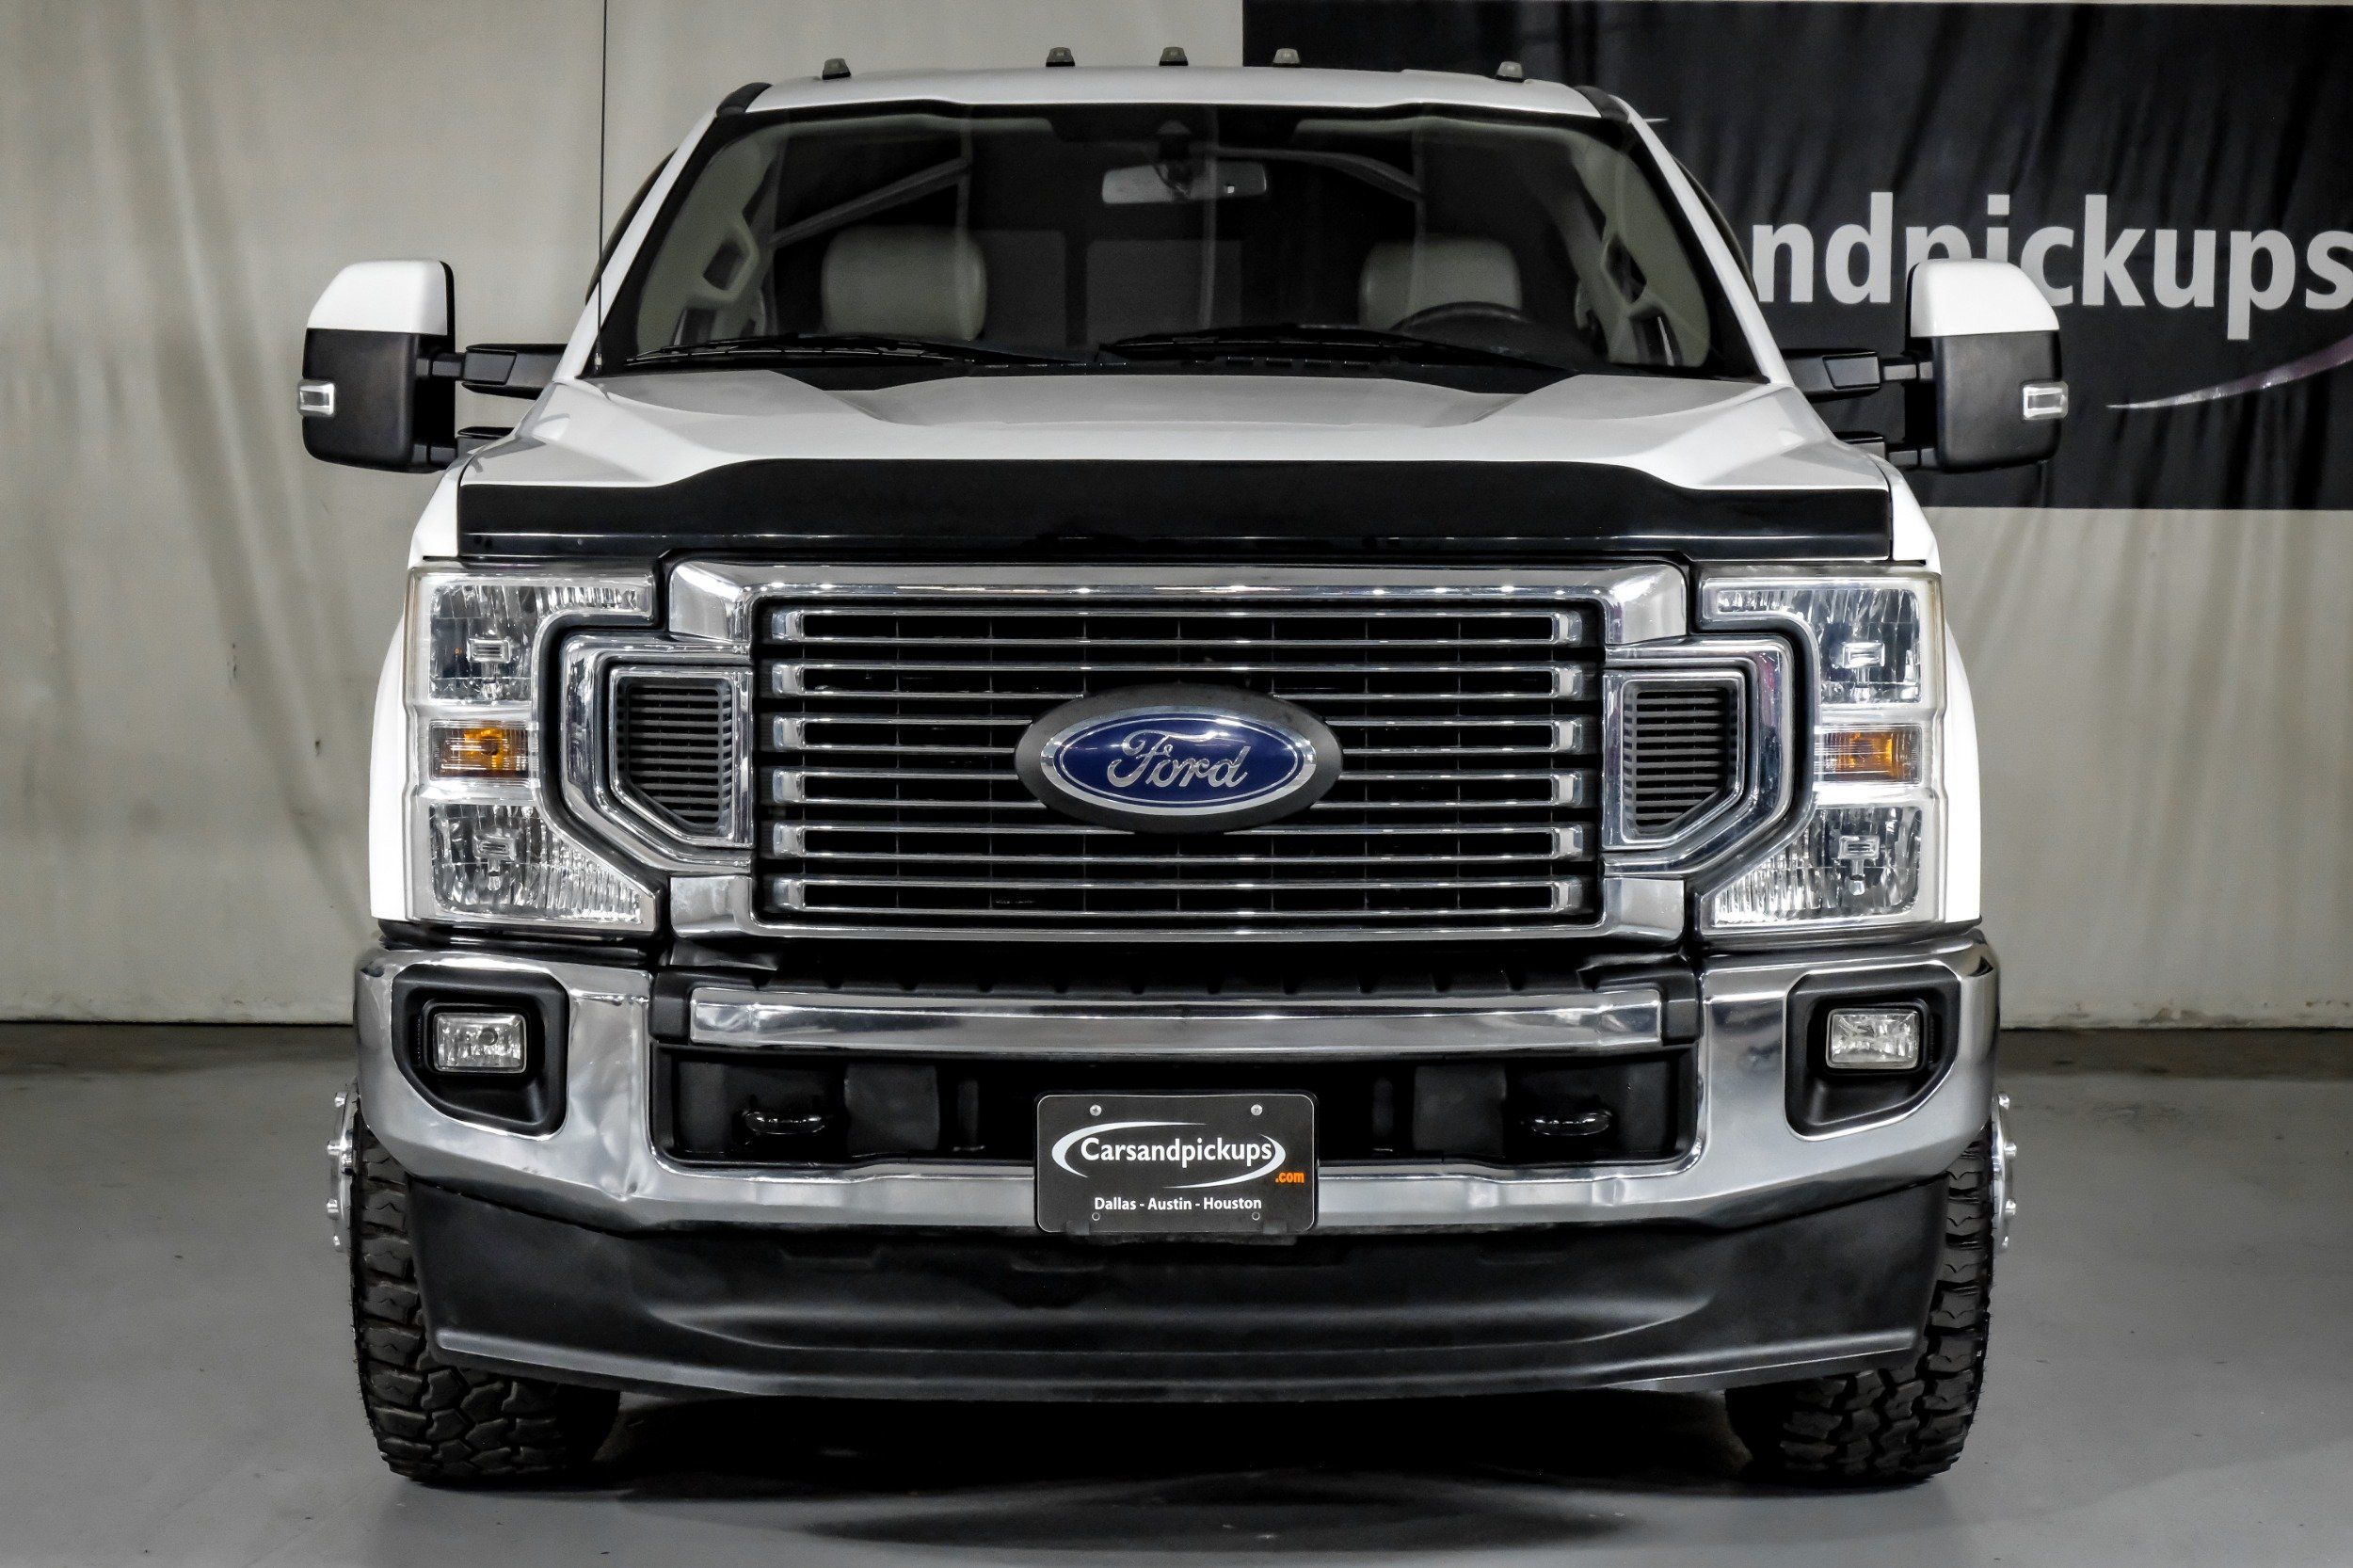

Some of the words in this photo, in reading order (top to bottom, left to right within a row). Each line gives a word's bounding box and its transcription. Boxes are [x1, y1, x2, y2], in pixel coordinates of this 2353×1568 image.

[1107, 728, 1252, 789] Ford
[1080, 1137, 1273, 1169] Carsandpickups
[1274, 1171, 1305, 1184] .com
[1094, 1196, 1137, 1210] Dallas
[1147, 1196, 1193, 1211] Austin
[1203, 1196, 1262, 1210] Houston
